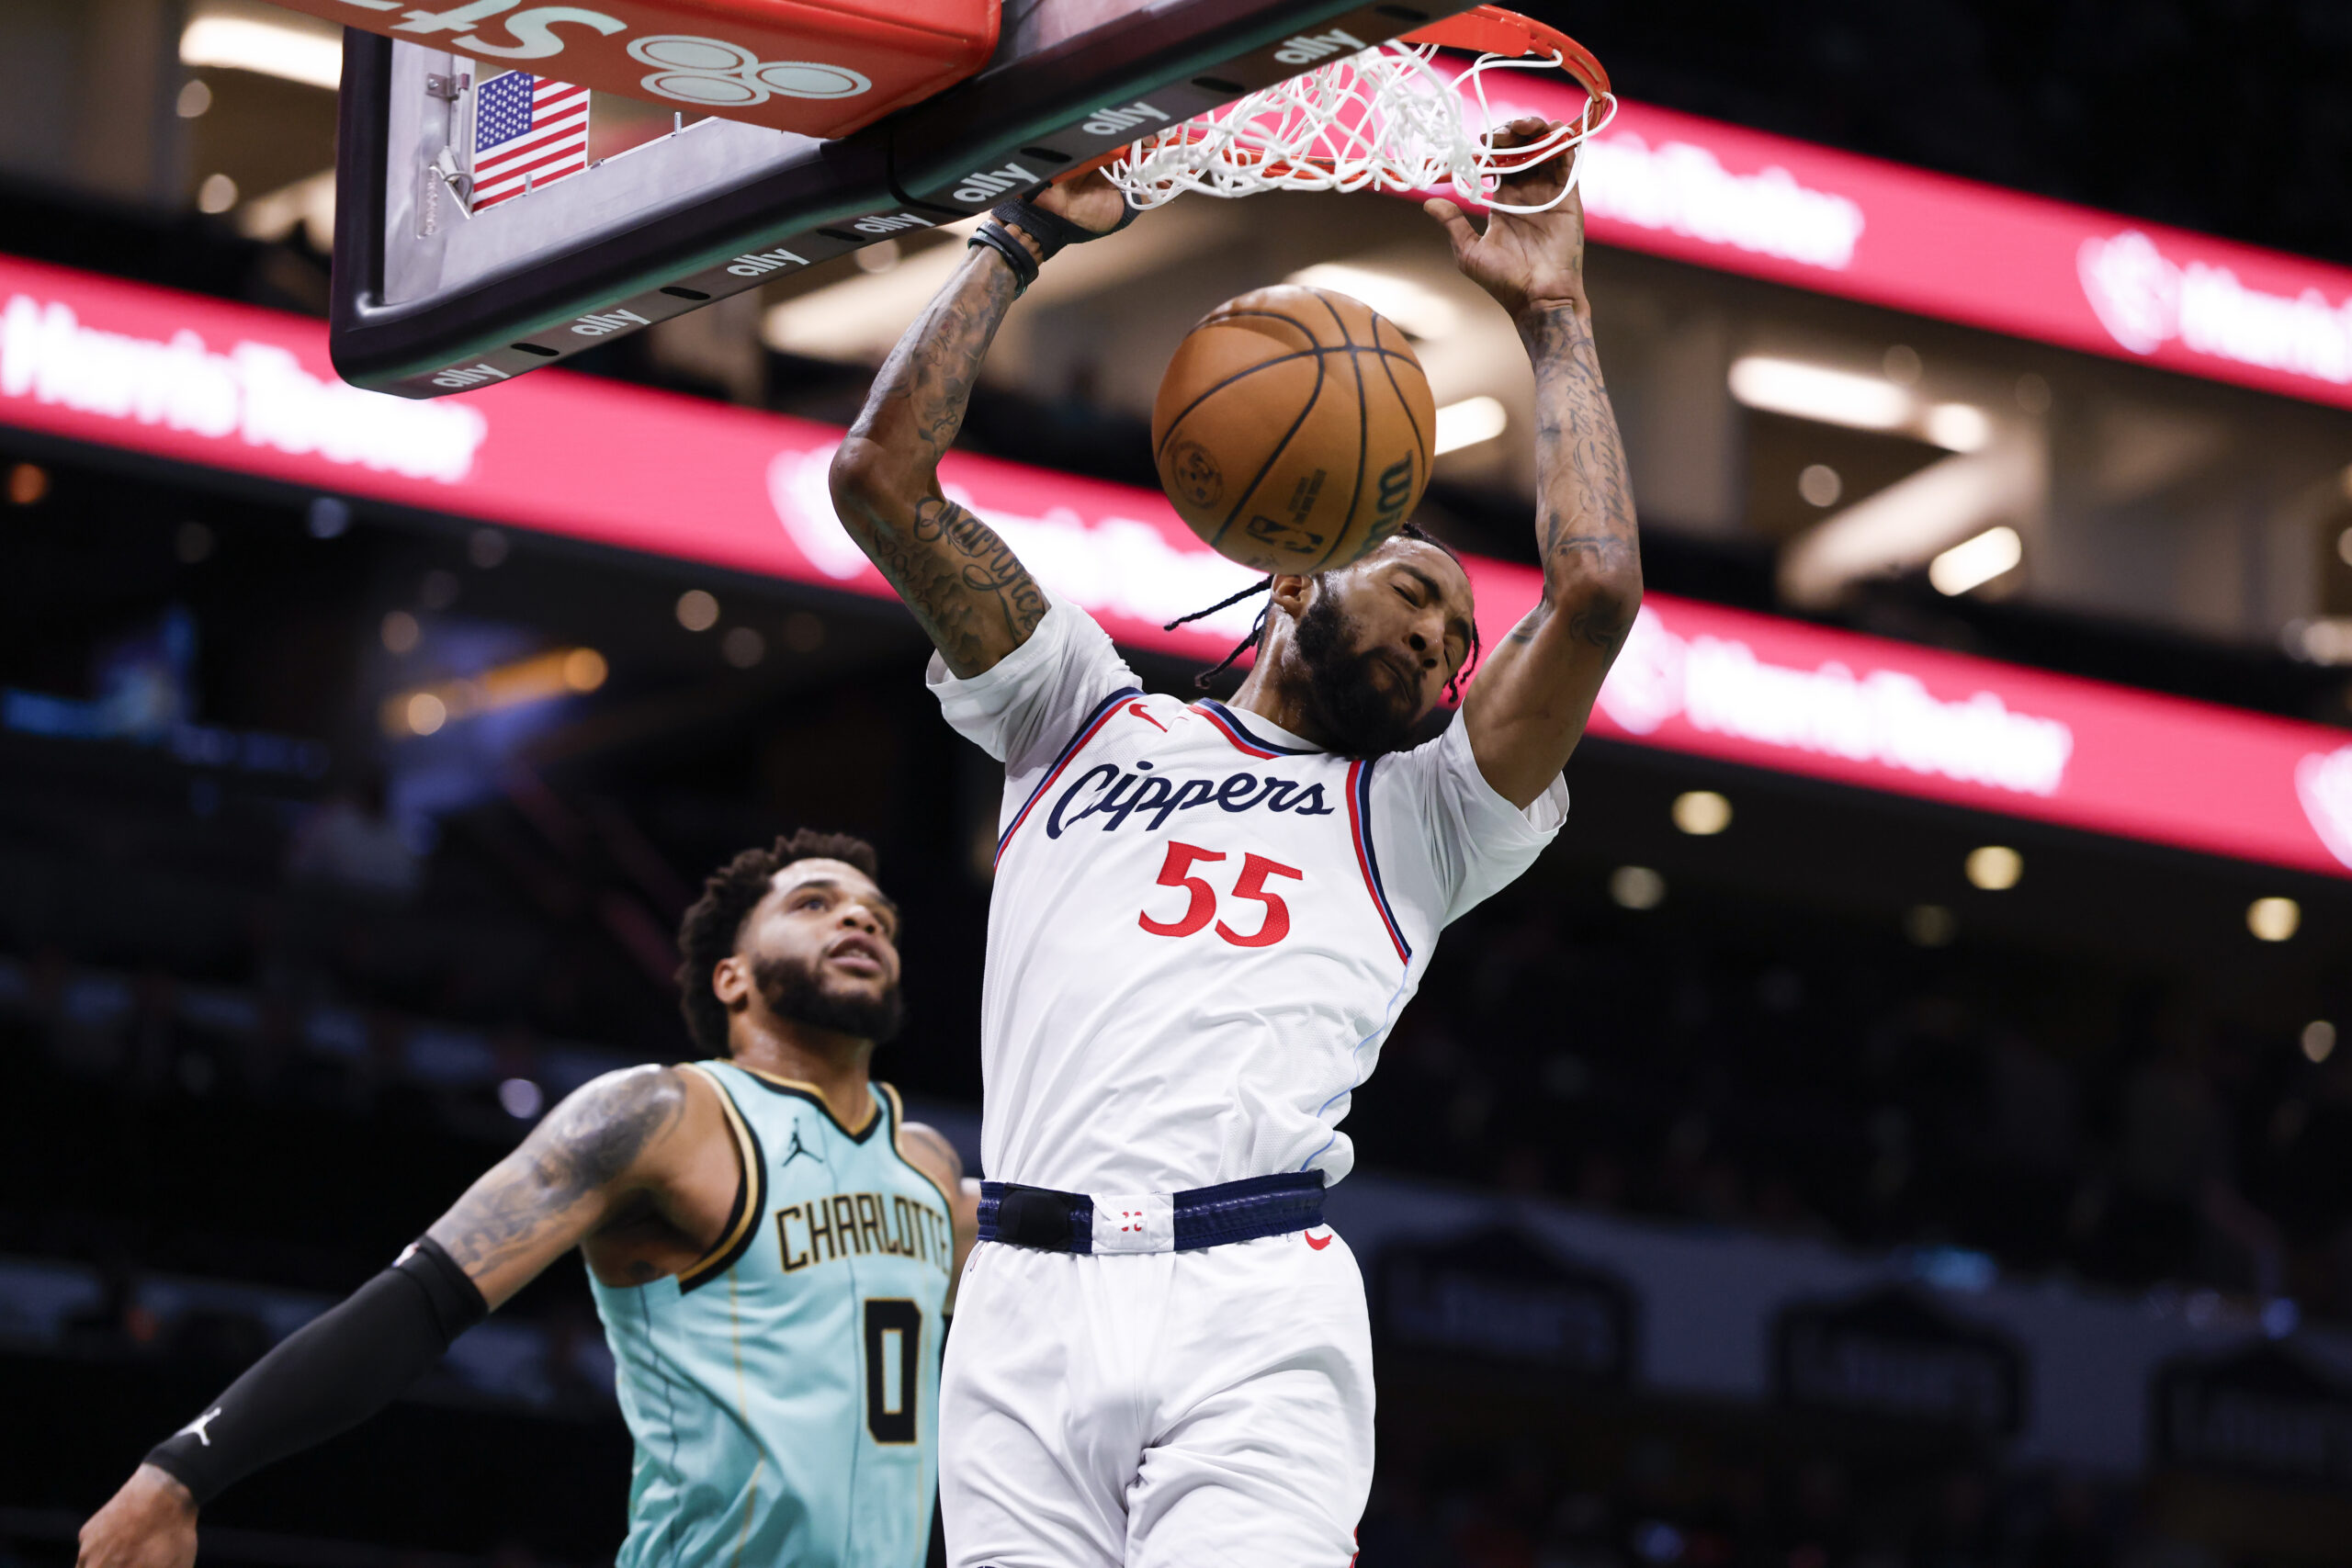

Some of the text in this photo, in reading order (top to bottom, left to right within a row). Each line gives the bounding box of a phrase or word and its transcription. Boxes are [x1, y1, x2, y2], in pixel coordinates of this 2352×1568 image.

[1274, 28, 1367, 64] ally
[1082, 101, 1170, 136] ally
[954, 163, 1040, 202] ally
[854, 212, 935, 234] ally
[727, 248, 810, 276] ally
[571, 308, 651, 336] ally
[432, 363, 512, 388] ally
[1046, 761, 1336, 840] Clippers
[1138, 840, 1304, 948] 55
[775, 1191, 950, 1276] CHARLOTTE
[865, 1298, 922, 1444] 0
